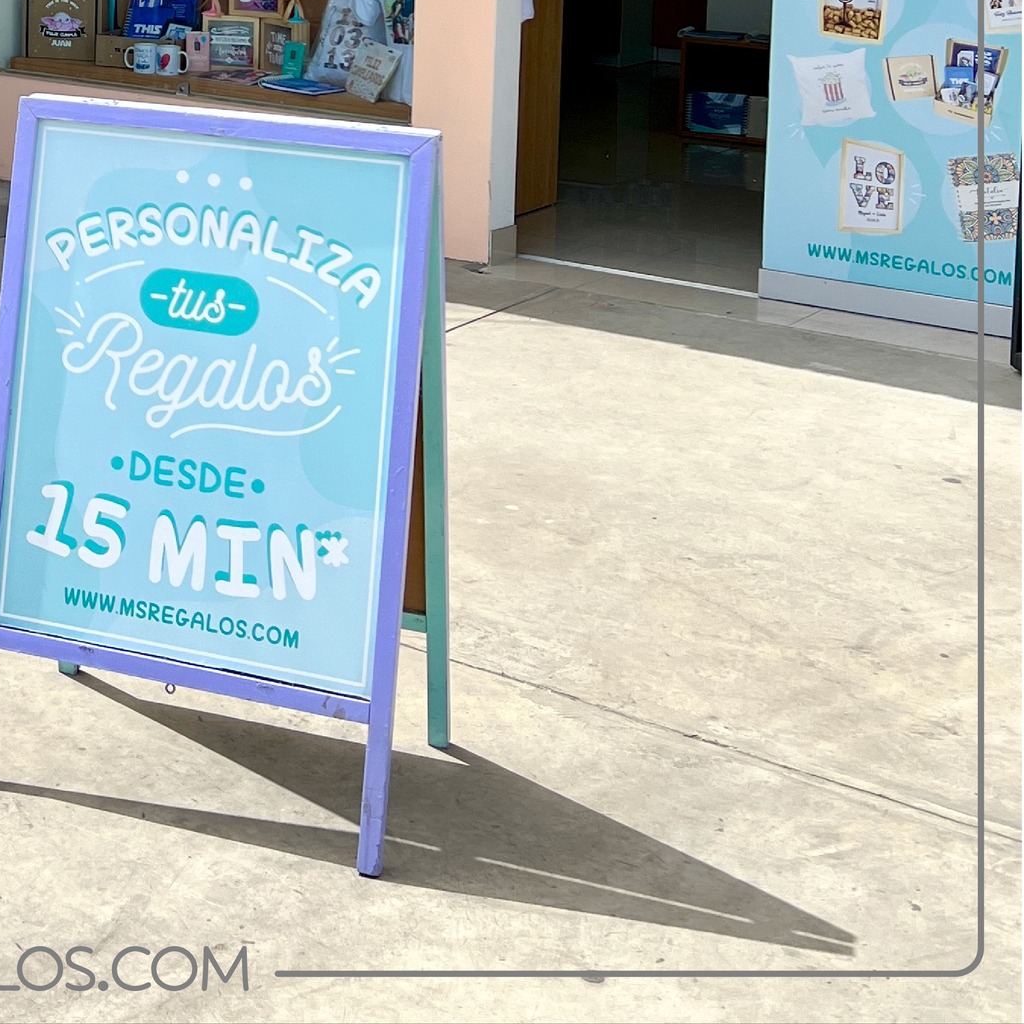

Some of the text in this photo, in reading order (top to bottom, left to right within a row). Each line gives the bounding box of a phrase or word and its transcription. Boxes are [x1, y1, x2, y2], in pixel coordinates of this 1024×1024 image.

[51, 39, 72, 47] JUAN
[133, 24, 163, 35] THIS
[44, 202, 382, 309] PERSONALIZA
[807, 242, 1012, 286] WWW.MSREGALOS.COM
[61, 311, 333, 430] Regalos
[25, 480, 133, 569] 15
[63, 586, 301, 650] WWW.MSREGALOS.COM
